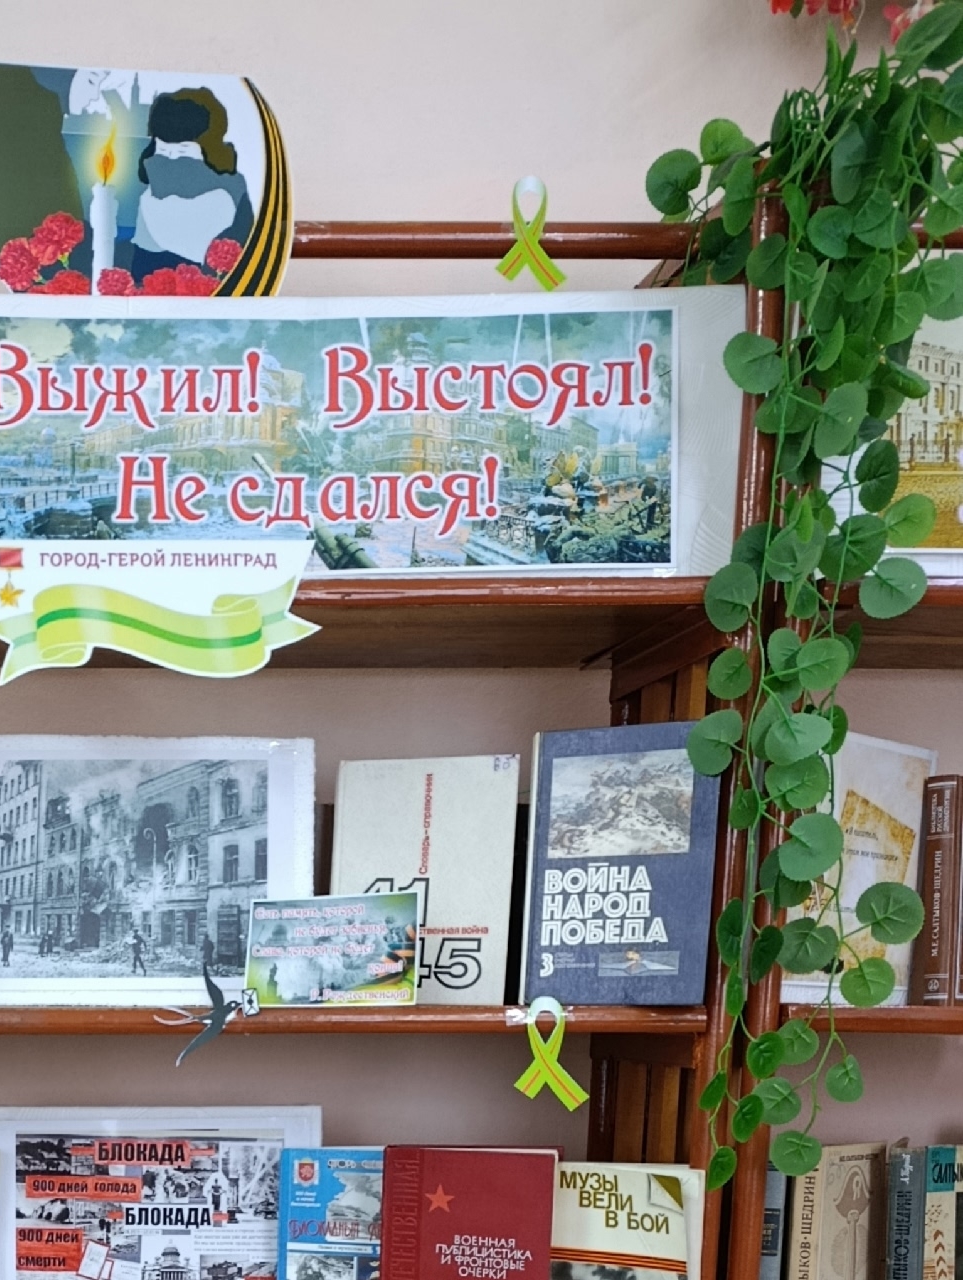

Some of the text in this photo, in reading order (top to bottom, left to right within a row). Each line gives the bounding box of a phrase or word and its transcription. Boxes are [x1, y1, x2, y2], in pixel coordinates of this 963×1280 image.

[322, 342, 654, 430] Выстоял!
[116, 454, 501, 537] Не сдался!
[39, 550, 279, 571] ГОРОД-ГЕРОЙ ЛЕНИНГРАД
[543, 862, 653, 894] ВОЙНА
[542, 892, 651, 920] НАРОД
[461, 925, 490, 936] война
[540, 916, 669, 947] ПОБЕДА
[539, 952, 555, 979] 3
[97, 1141, 187, 1163] БЛОКАДА
[32, 1180, 137, 1195] 900 дней голода
[559, 1170, 619, 1192] МУЗЫ
[578, 1189, 634, 1213] ВЕЛИ
[124, 1205, 212, 1227] БЛОКАДА
[604, 1209, 670, 1236] В БОЙ
[17, 1229, 80, 1246] 900 дней
[454, 1234, 516, 1249] ВОЕННАЯ
[17, 1254, 67, 1272] смерти
[435, 1243, 533, 1262] ПУБЛИЦИСТИКА
[440, 1254, 526, 1272] И ФРОНТОВЫЕ
[457, 1267, 507, 1280] ОЧЕРКИ
